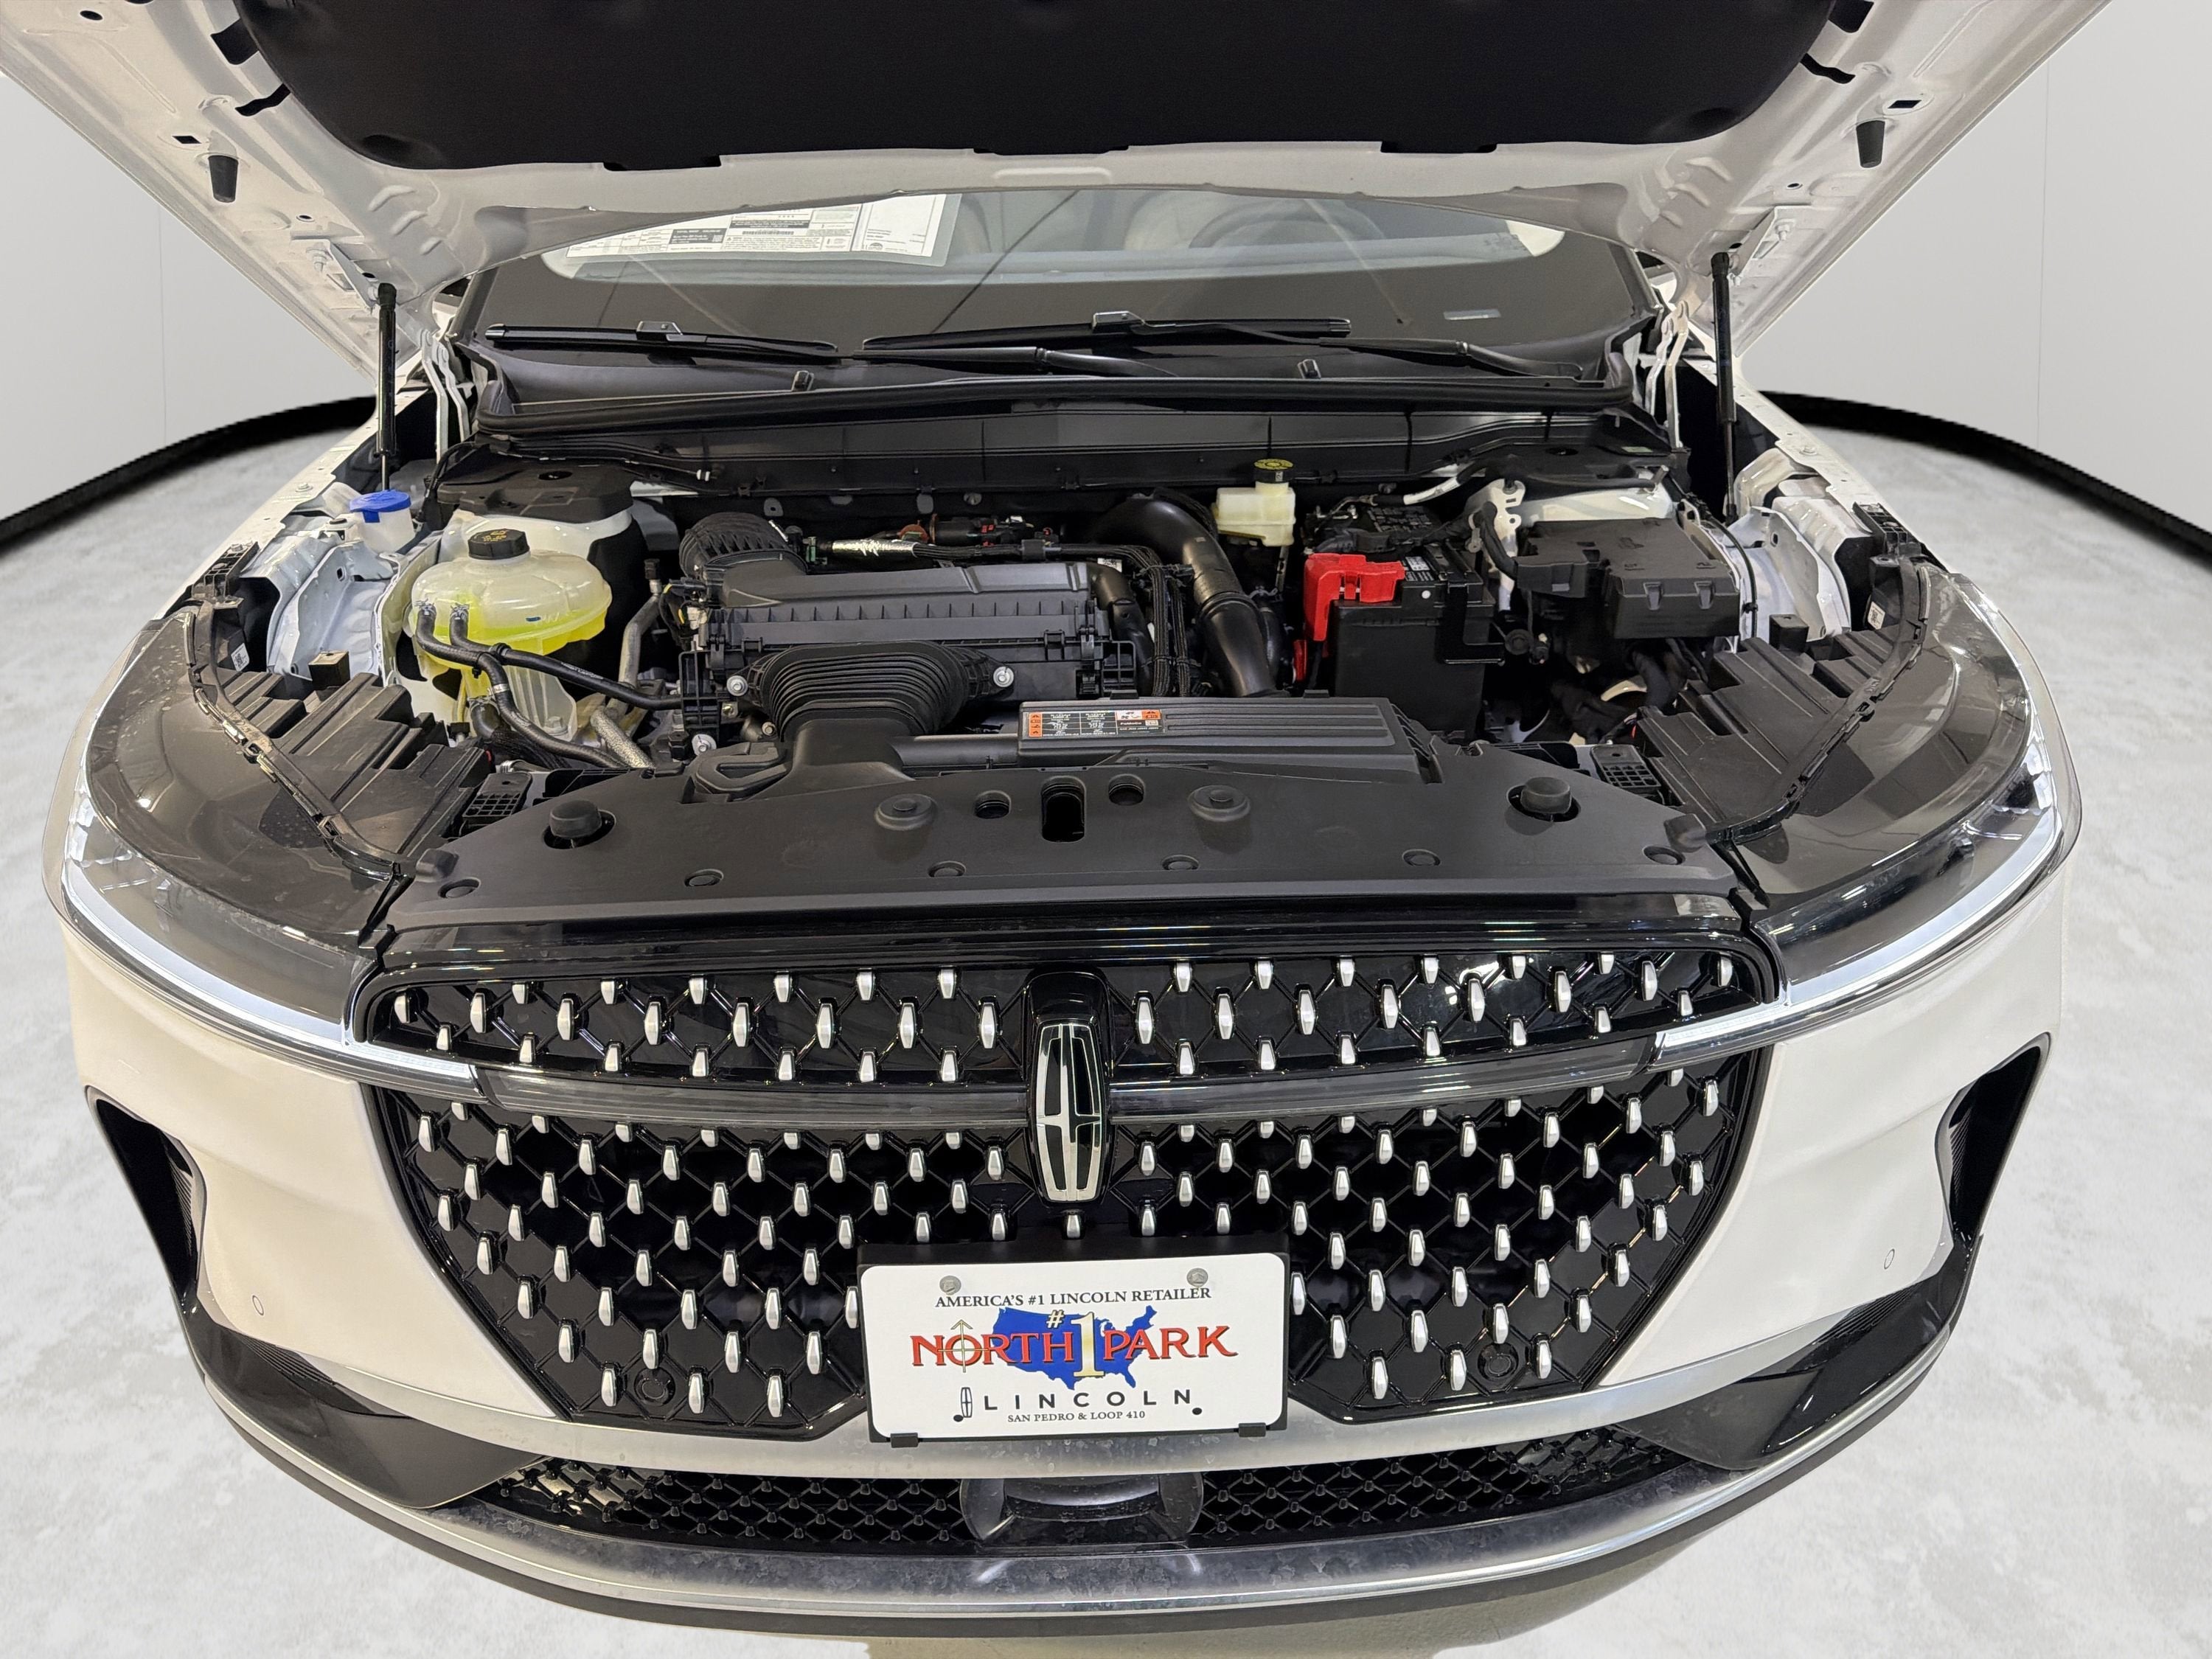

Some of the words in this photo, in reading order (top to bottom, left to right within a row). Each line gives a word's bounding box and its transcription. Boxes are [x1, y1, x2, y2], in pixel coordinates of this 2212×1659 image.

[935, 1295, 1023, 1307] AMERICA'S
[1028, 1295, 1043, 1305] #1
[1050, 1291, 1127, 1304] LINCOLN
[1132, 1288, 1211, 1301] RETAILER
[910, 1331, 1074, 1367] NORTH
[1103, 1326, 1238, 1360] PARK
[984, 1389, 1191, 1411] LINCOLN
[1007, 1414, 1030, 1422] SAN
[1034, 1413, 1074, 1422] PEDRO
[1077, 1412, 1087, 1420] &
[1091, 1411, 1122, 1419] LOOP
[1126, 1411, 1145, 1419] 410
